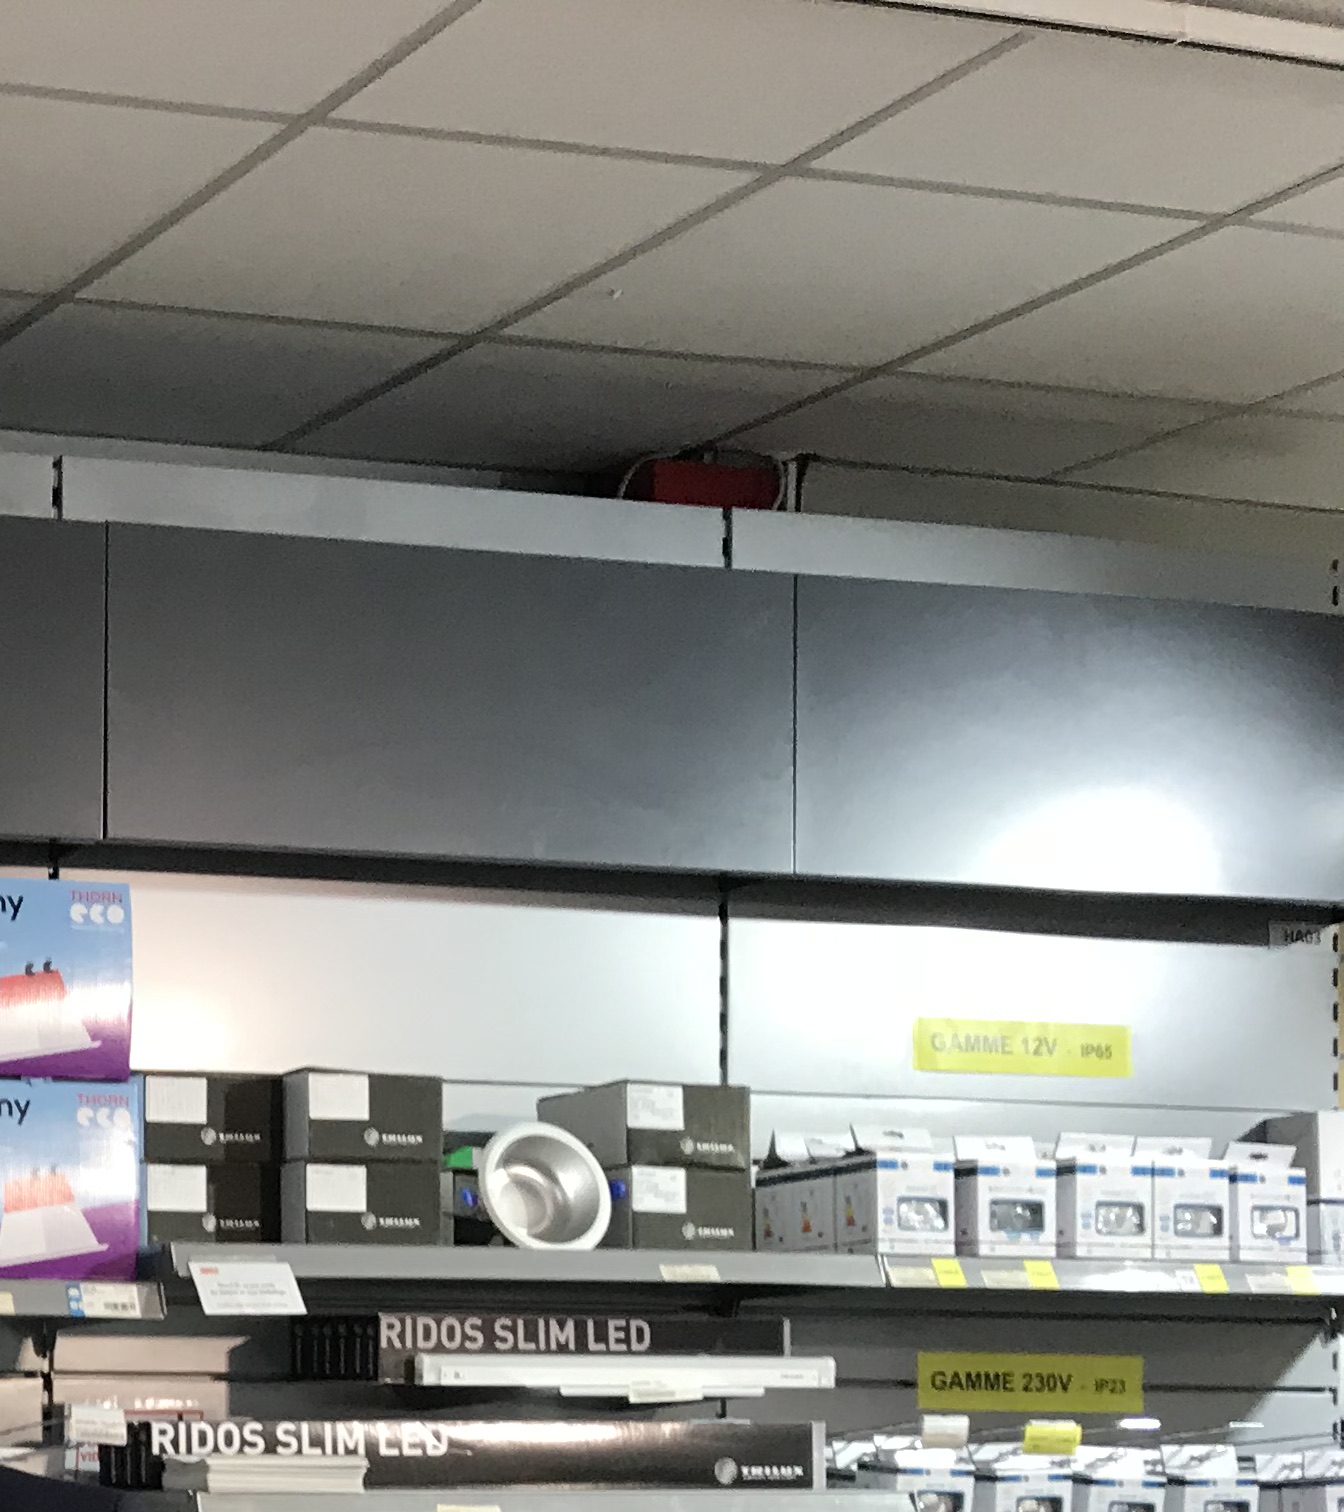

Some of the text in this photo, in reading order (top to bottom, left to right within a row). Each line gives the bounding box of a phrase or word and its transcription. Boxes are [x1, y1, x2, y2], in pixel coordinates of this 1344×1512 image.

[930, 1032, 1013, 1056] GAMME
[1021, 1036, 1058, 1058] 12V
[379, 1318, 652, 1352] RIDOS SLIM LED
[930, 1370, 1015, 1393] GAMME
[1021, 1372, 1073, 1393] 230V
[150, 1420, 449, 1457] RIDOS SLIM LED
